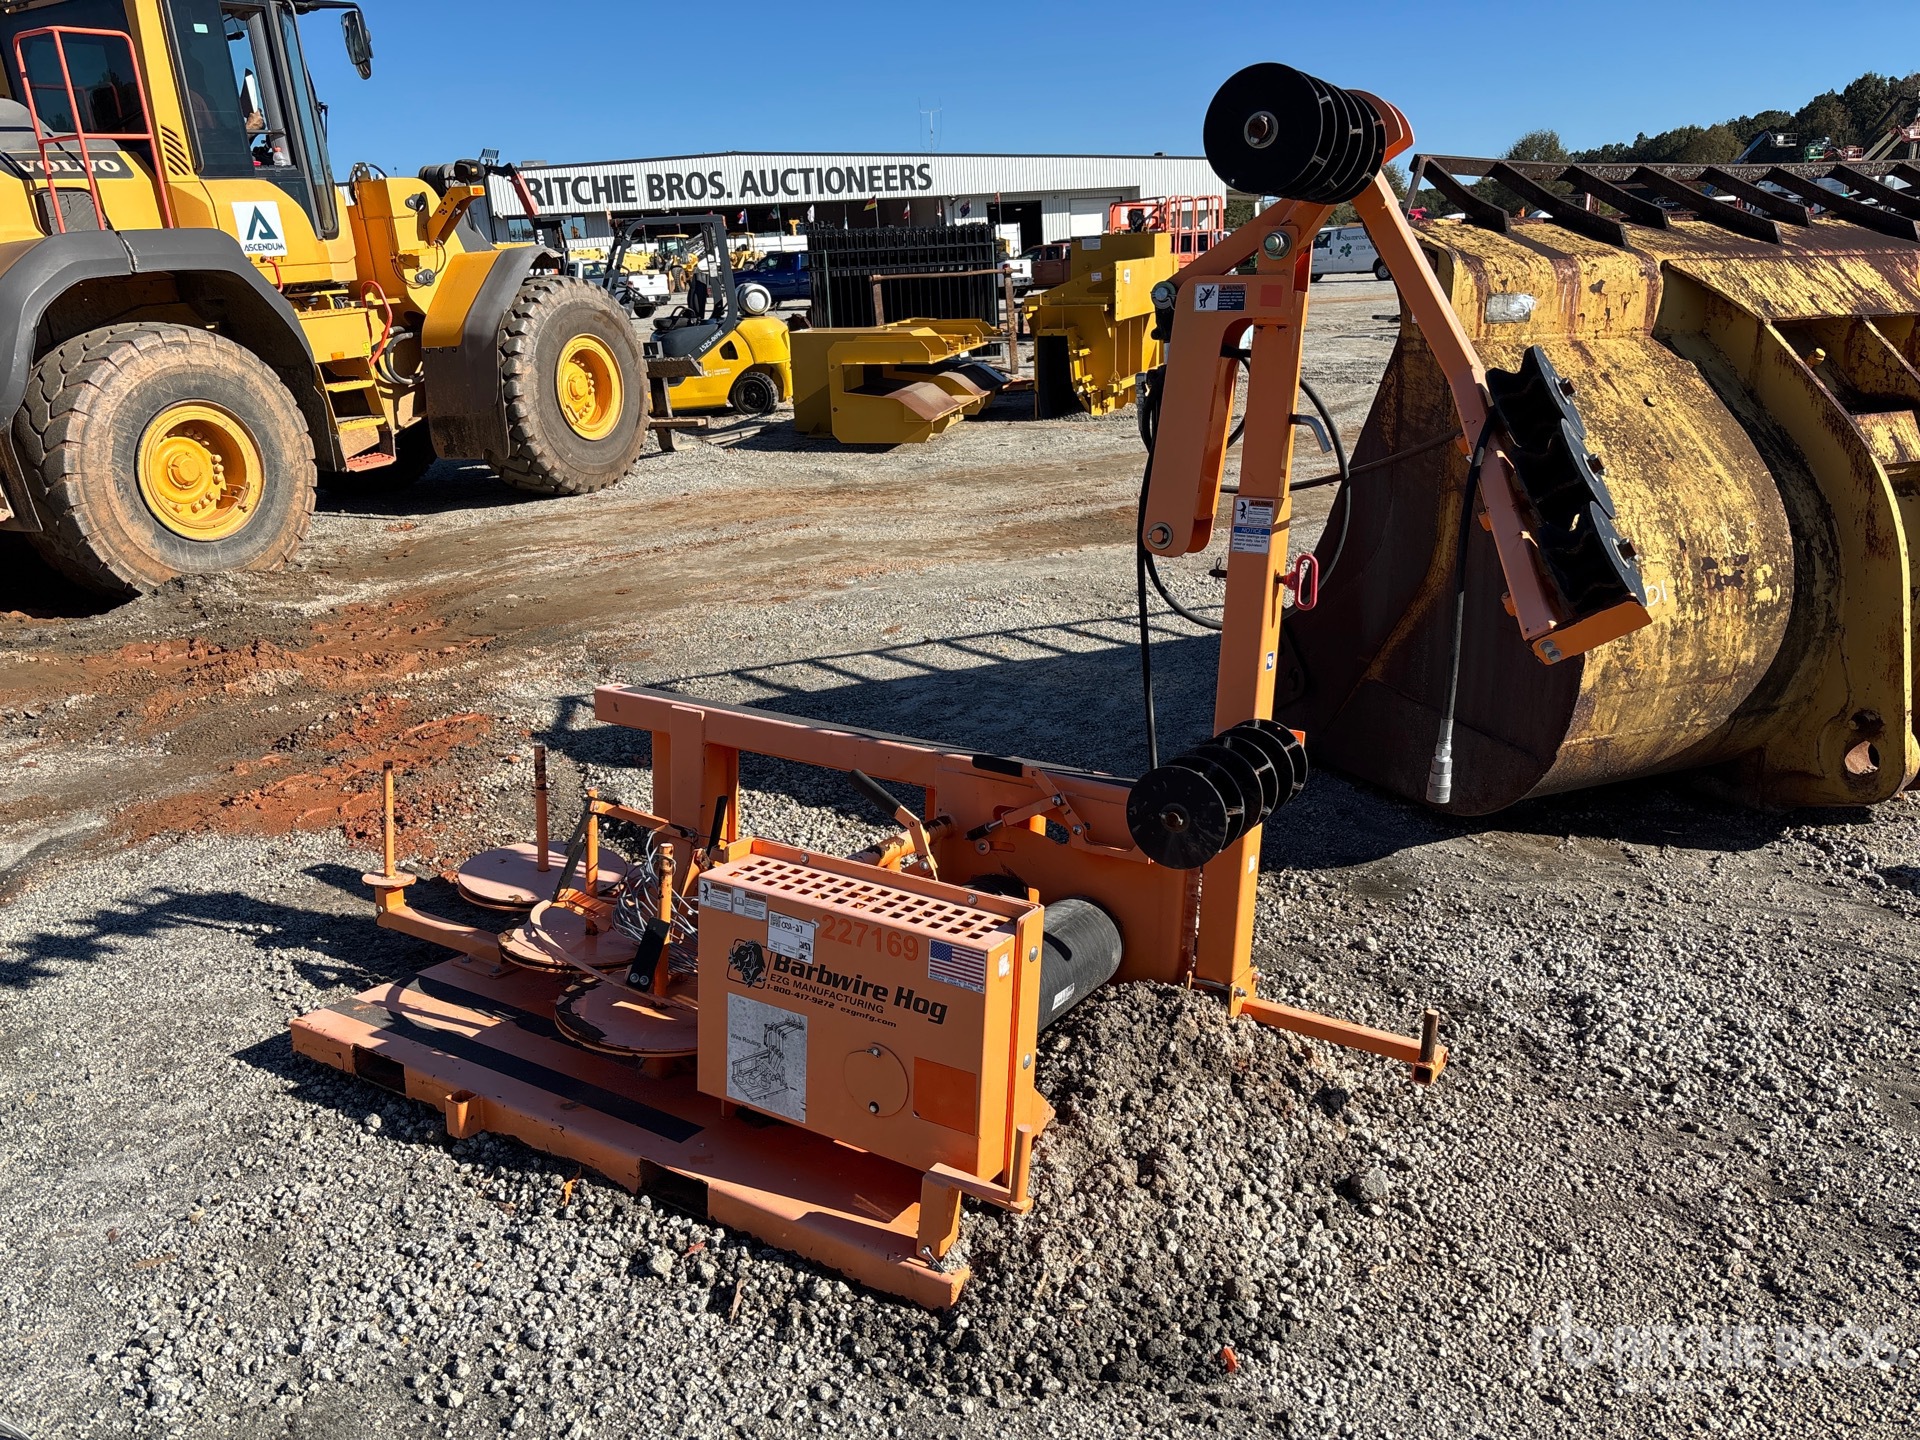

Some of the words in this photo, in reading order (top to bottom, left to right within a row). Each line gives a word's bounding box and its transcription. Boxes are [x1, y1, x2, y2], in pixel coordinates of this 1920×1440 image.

[529, 175, 637, 206] RITCHIE
[646, 170, 733, 202] BROS.
[740, 163, 932, 198] AUCTIONEERS
[244, 242, 286, 252] ASCENDUM
[821, 914, 919, 962] 227169
[766, 983, 835, 1009] 1-800-417-9272
[840, 1006, 897, 1028] ezgmfg.com
[770, 974, 790, 986] EZG
[793, 980, 884, 1014] MANUFACTURING
[773, 952, 888, 1001] Barbwire
[893, 986, 948, 1025] Hog
[742, 1036, 762, 1049] Routing
